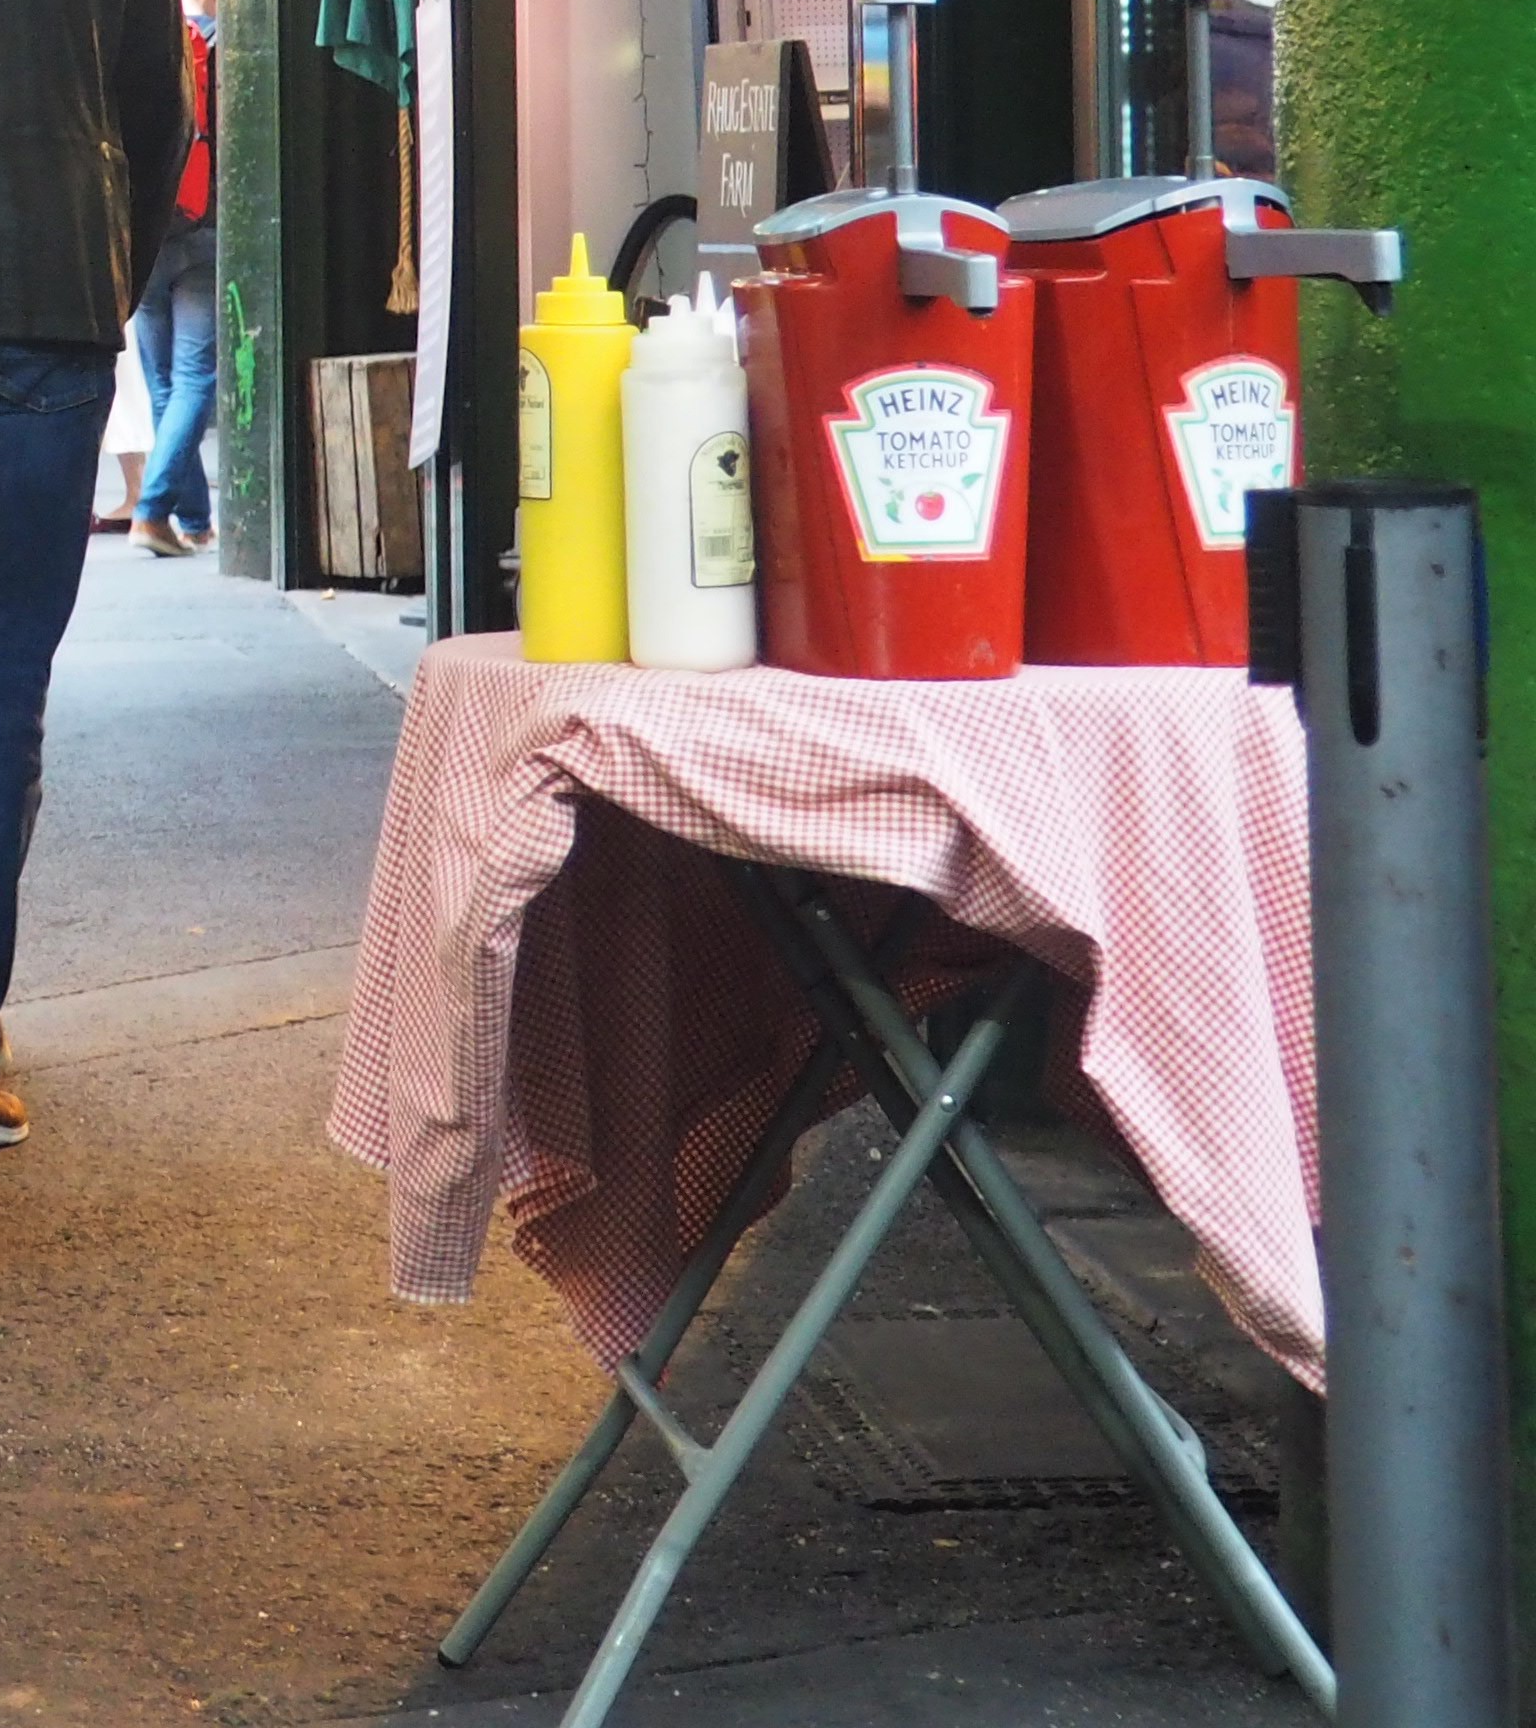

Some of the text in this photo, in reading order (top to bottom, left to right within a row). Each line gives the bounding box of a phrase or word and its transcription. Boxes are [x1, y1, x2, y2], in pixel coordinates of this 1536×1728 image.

[720, 152, 755, 218] FARM
[878, 388, 964, 418] HEINZ
[1211, 380, 1271, 410] HEINZ
[876, 430, 970, 452] TOMATO
[1209, 422, 1276, 443] TOMATO
[883, 452, 969, 470] KETCHUP
[1216, 443, 1275, 461] KETCHUP
